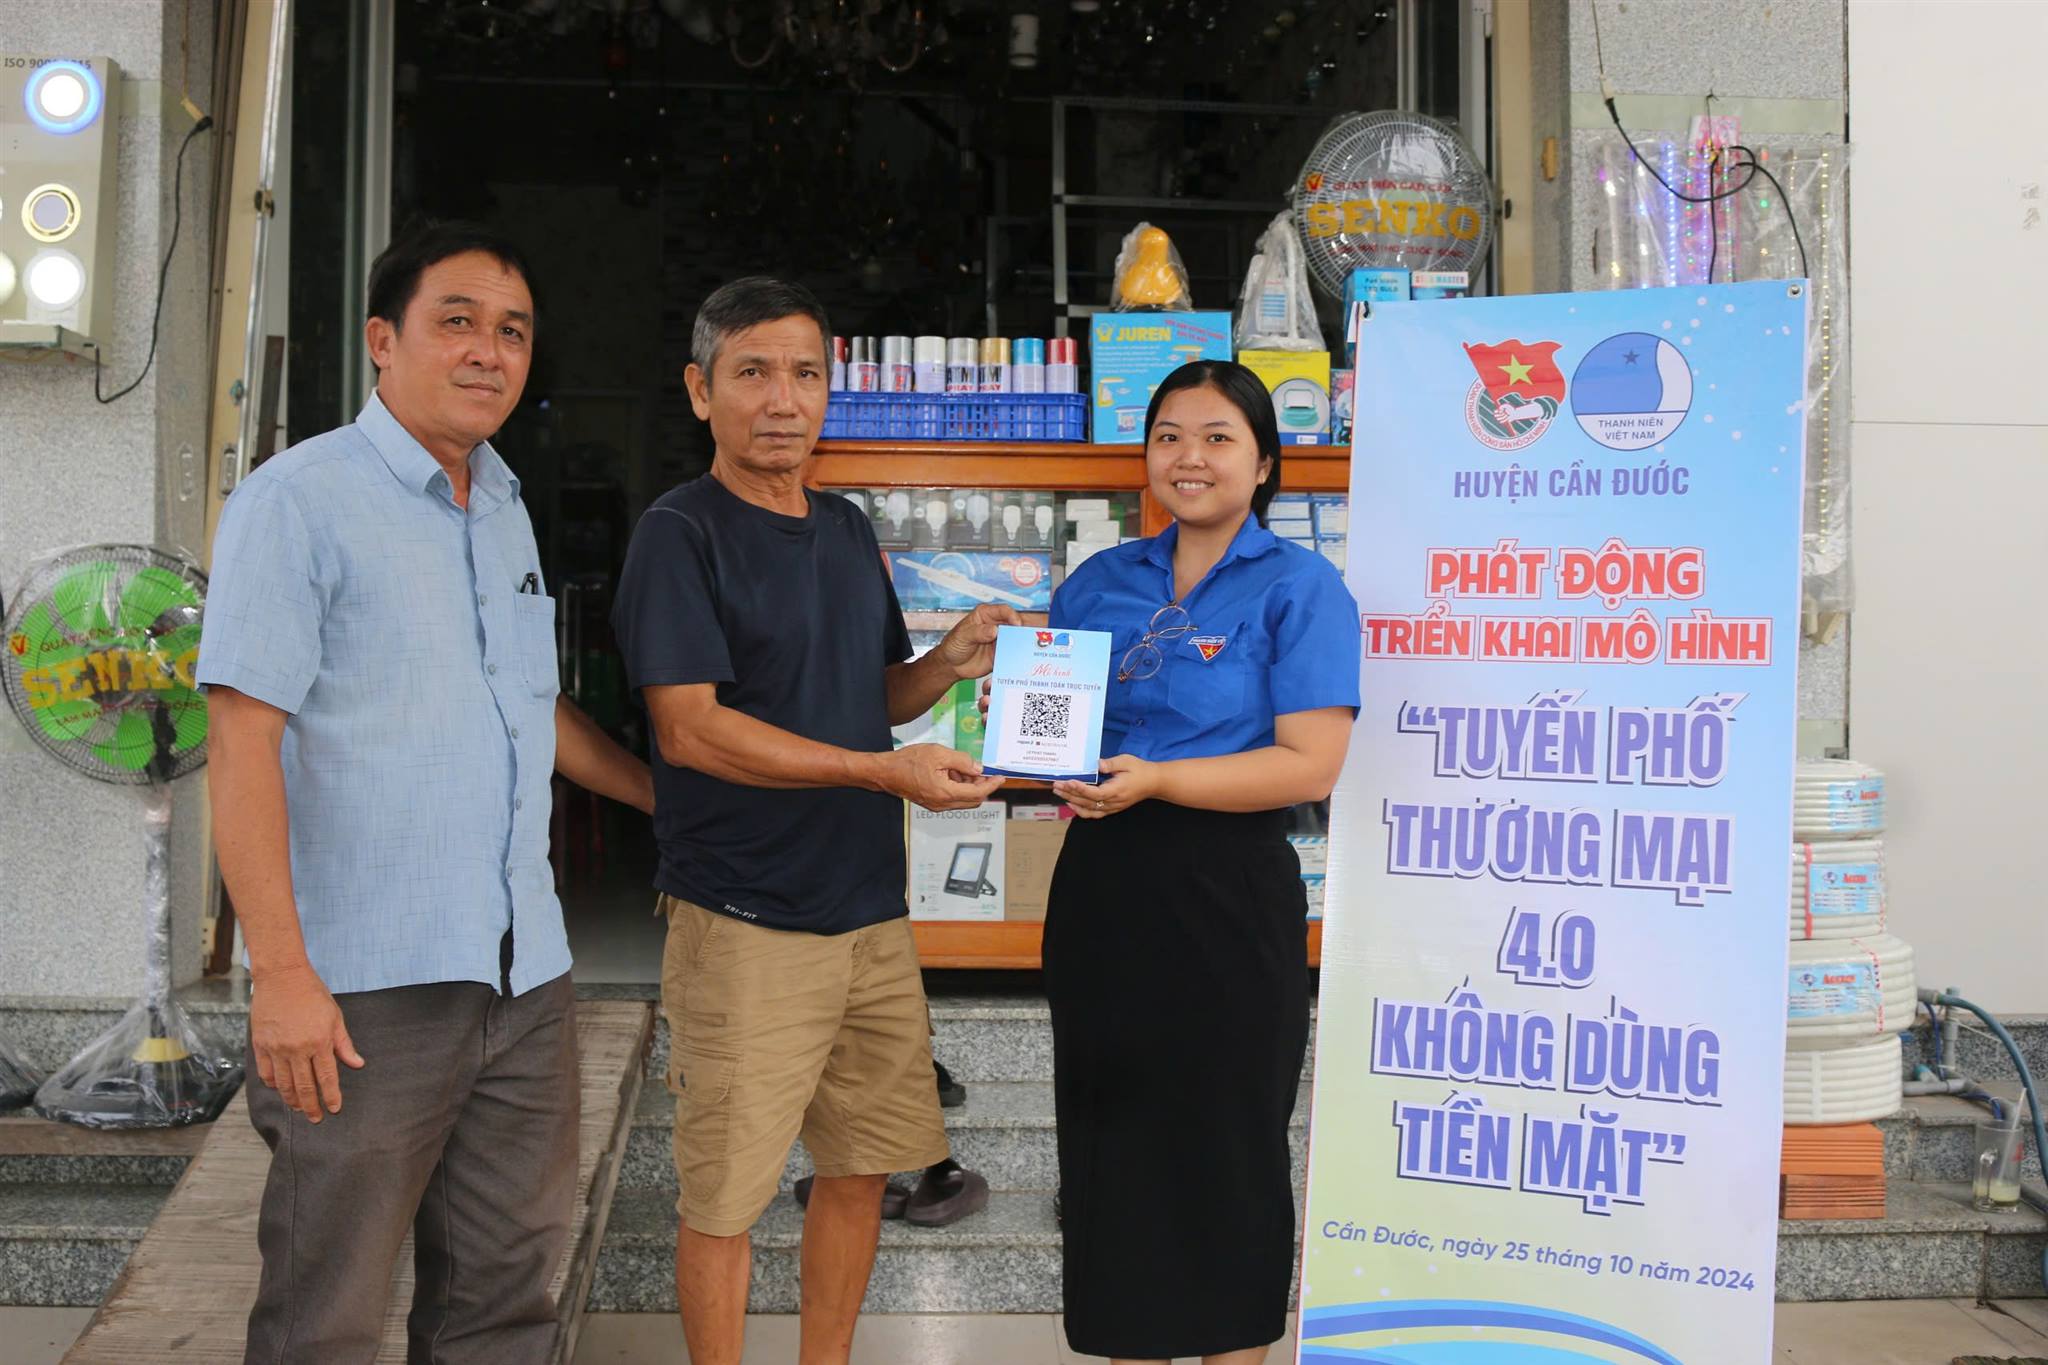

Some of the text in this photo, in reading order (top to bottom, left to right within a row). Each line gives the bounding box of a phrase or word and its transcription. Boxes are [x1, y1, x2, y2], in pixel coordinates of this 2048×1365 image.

[4, 57, 26, 68] ISO
[1306, 198, 1481, 241] SENKO
[1116, 326, 1171, 342] JUREN
[1598, 416, 1664, 428] THANH NIÊN
[1604, 430, 1656, 441] VIỆT NAM
[1453, 459, 1690, 504] HUYỆN CẦN ĐƯỚC
[1429, 542, 1700, 605] PHÁT ĐỘNG
[1365, 604, 1766, 661] TRIỂN KHAI MÔ HÌNH
[1029, 680, 1049, 688] THANH
[1404, 693, 1736, 781] “TUYẾN PHỐ
[972, 810, 1001, 820] LIGHT
[1389, 801, 1732, 899] THƯƠNG MẠI
[723, 903, 758, 920] DRI-FIT
[1503, 910, 1597, 982] 4.0
[1377, 991, 1721, 1099] KHÔNG DÙNG
[1400, 1095, 1687, 1207] TIỀN MẶT”
[1321, 1219, 1756, 1292] Cần Đước, ngày 25 tháng 10 năm 2024
